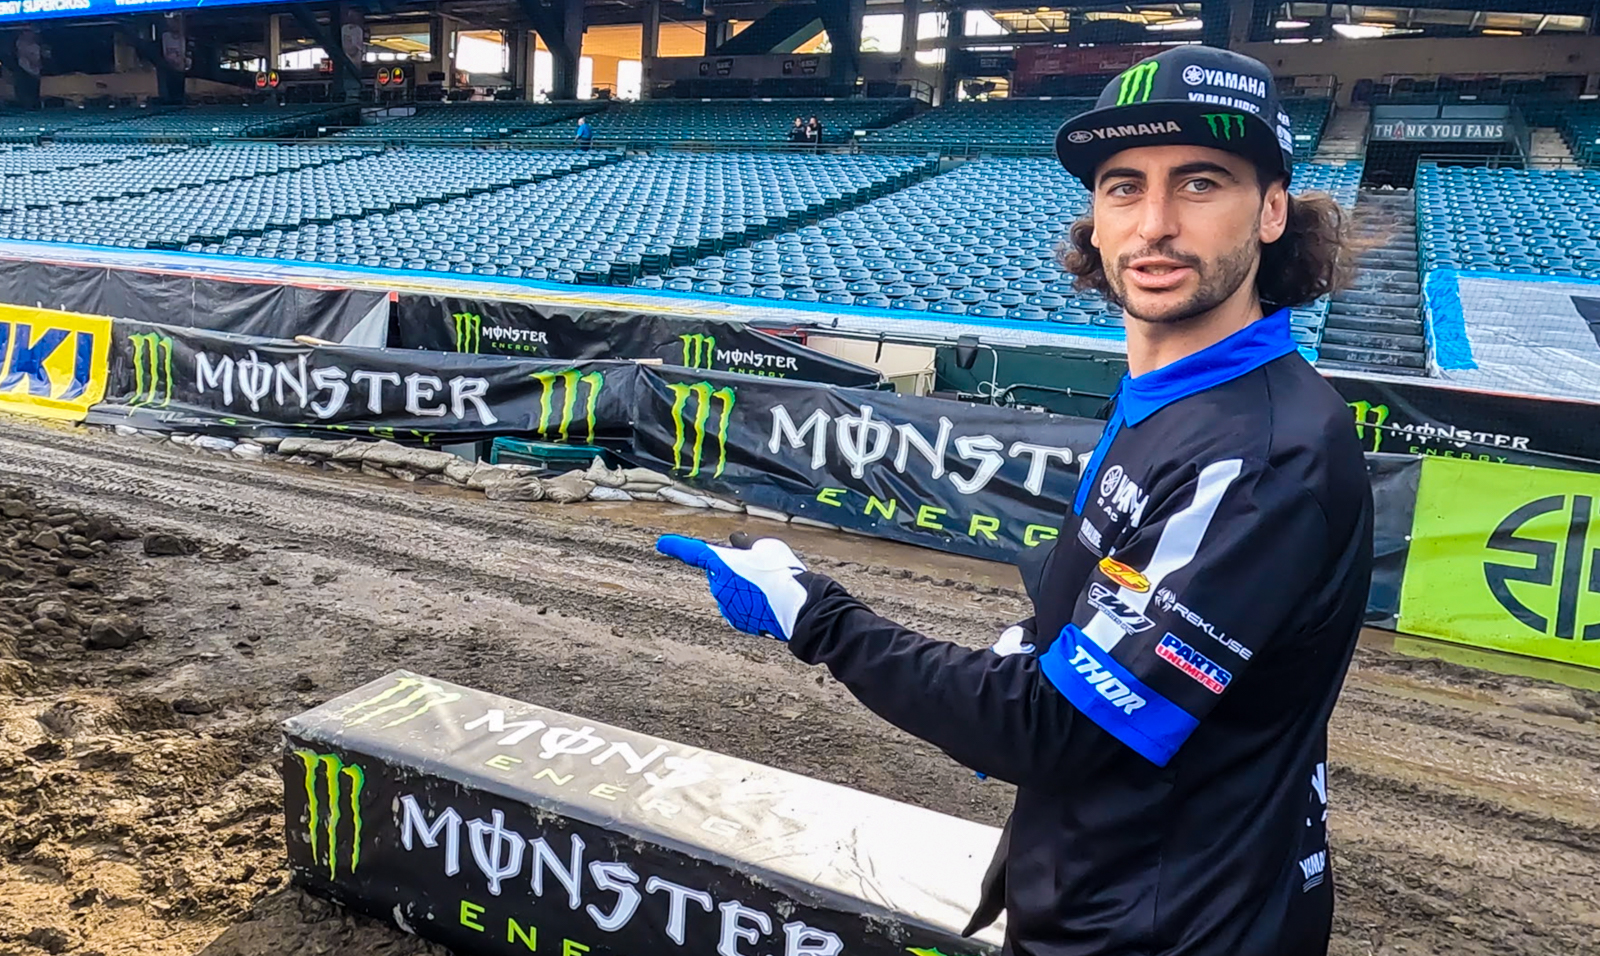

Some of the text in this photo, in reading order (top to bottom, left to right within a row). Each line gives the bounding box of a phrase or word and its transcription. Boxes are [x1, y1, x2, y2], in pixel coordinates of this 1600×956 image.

[1204, 69, 1266, 98] YAMAHA
[1092, 120, 1182, 140] YAMAHA
[1374, 120, 1504, 139] THANK YOU FANS
[482, 325, 549, 345] MONSTER
[491, 341, 538, 352] ENERGY
[716, 348, 799, 371] MONSTER
[194, 349, 498, 426] MONSTER
[1173, 602, 1253, 661] REKLUSE
[1156, 646, 1225, 694] UNLIMITED
[1161, 633, 1232, 688] PARTS
[1068, 645, 1147, 716] THOR
